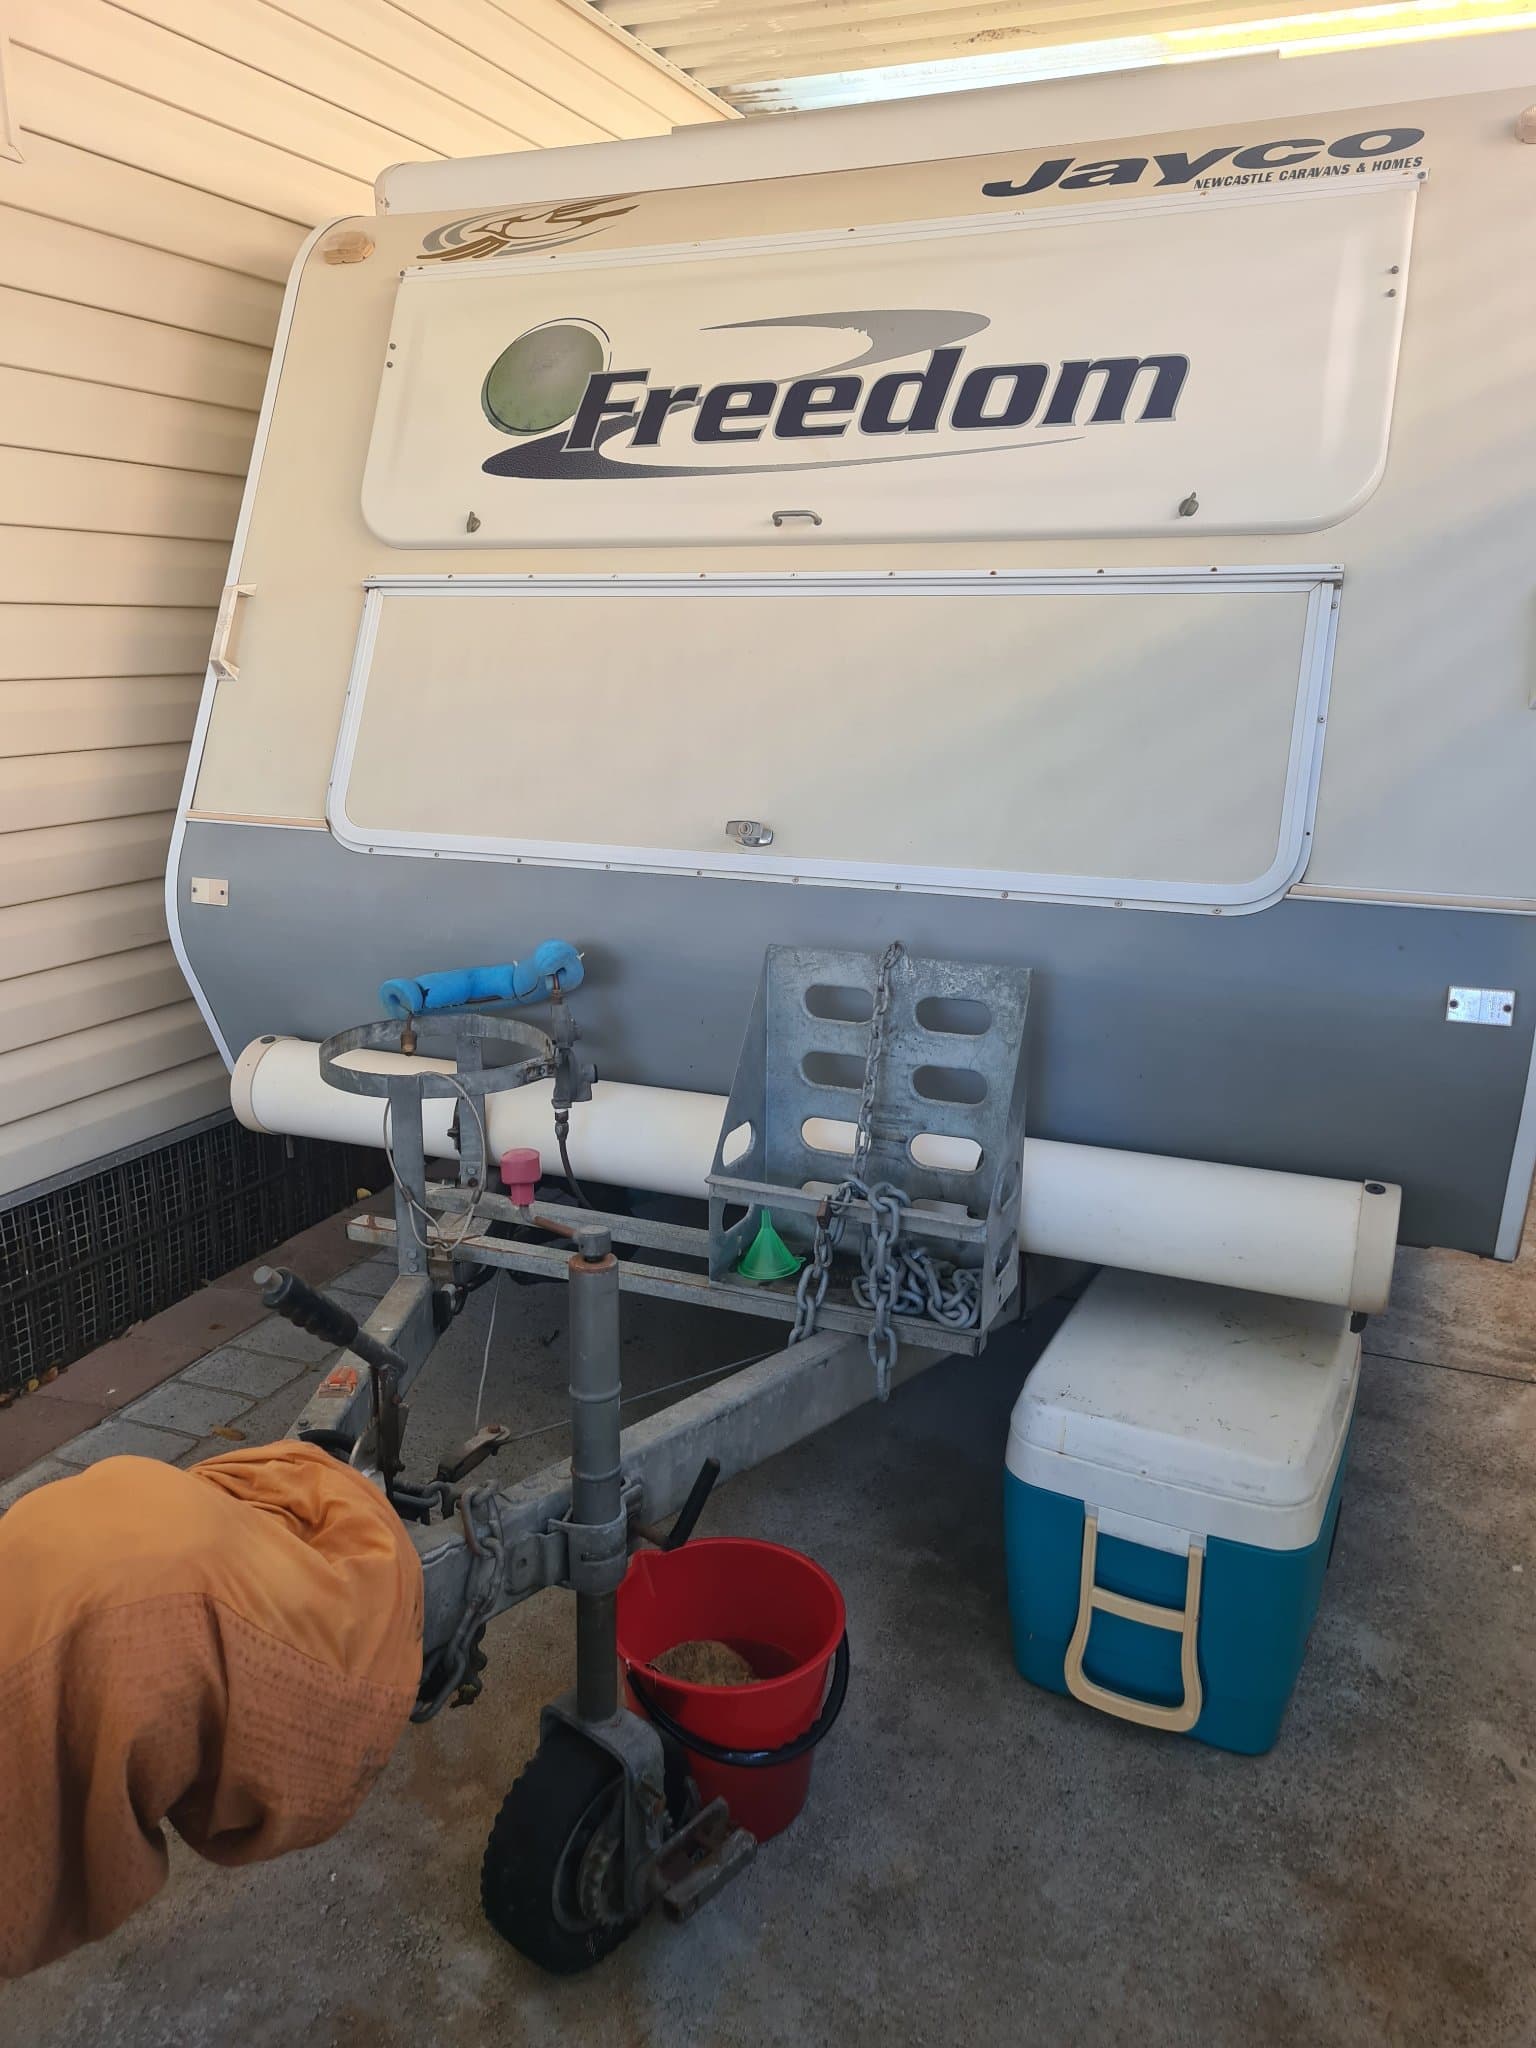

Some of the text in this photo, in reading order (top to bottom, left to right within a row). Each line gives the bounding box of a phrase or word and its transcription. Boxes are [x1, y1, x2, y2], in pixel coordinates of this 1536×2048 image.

[982, 127, 1425, 197] Jayco
[1194, 156, 1423, 190] NEWCASTLE CARAVANS & HOMES
[560, 345, 1190, 453] Freedom
